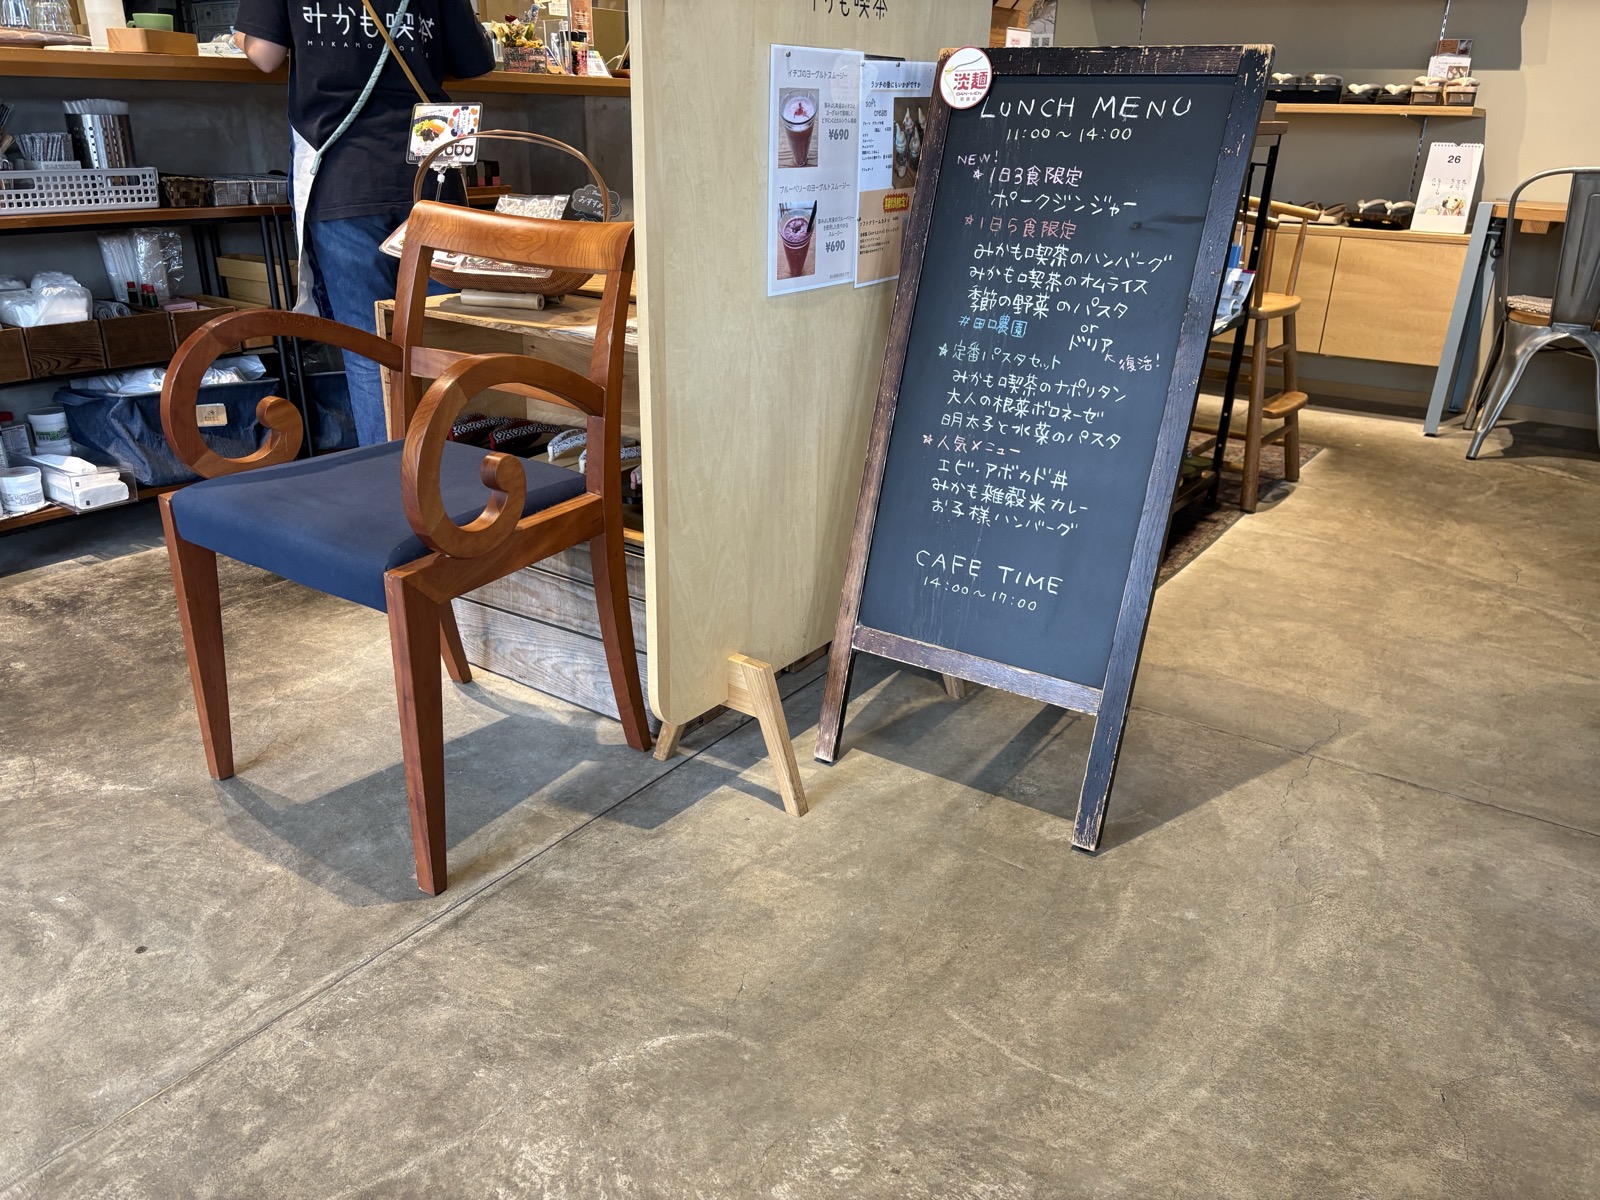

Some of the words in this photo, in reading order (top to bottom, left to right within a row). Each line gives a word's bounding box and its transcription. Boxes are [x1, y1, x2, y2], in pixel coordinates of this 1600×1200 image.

[302, 2, 435, 43] みかも喫茶
[307, 40, 373, 49] MIKAMO
[980, 96, 1075, 118] LUNCH
[1091, 96, 1192, 120] MENU
[828, 128, 849, 141] ¥690
[957, 150, 999, 166] NEW!
[1447, 155, 1461, 164] 26
[988, 165, 1083, 187] 1日3食限定
[991, 191, 1138, 217] ポークジンジャー
[979, 217, 1077, 239] 1日5食限定
[825, 240, 845, 253] ¥690
[973, 242, 1173, 273] みかも喫茶のハンバーグ
[969, 266, 1148, 295] みかも喫茶のオムライス
[967, 285, 1129, 319] 季節の野菜のパスタ
[1080, 323, 1100, 334] or
[952, 340, 1061, 370] 定番パスタセット
[1068, 334, 1114, 354] ドリア
[952, 370, 1126, 402] みかも喫茶のナポリタン
[946, 387, 1105, 425] 大人の根菜ボロネーゼ
[941, 411, 1122, 450] 明太子と水菜のパスタ
[937, 434, 1021, 455] 人気メニュー
[931, 477, 1089, 515] みかも雑穀米カレー
[931, 498, 1079, 537] お子様ハンバーグ
[916, 550, 982, 577] CAFE
[998, 565, 1064, 595] TIME
